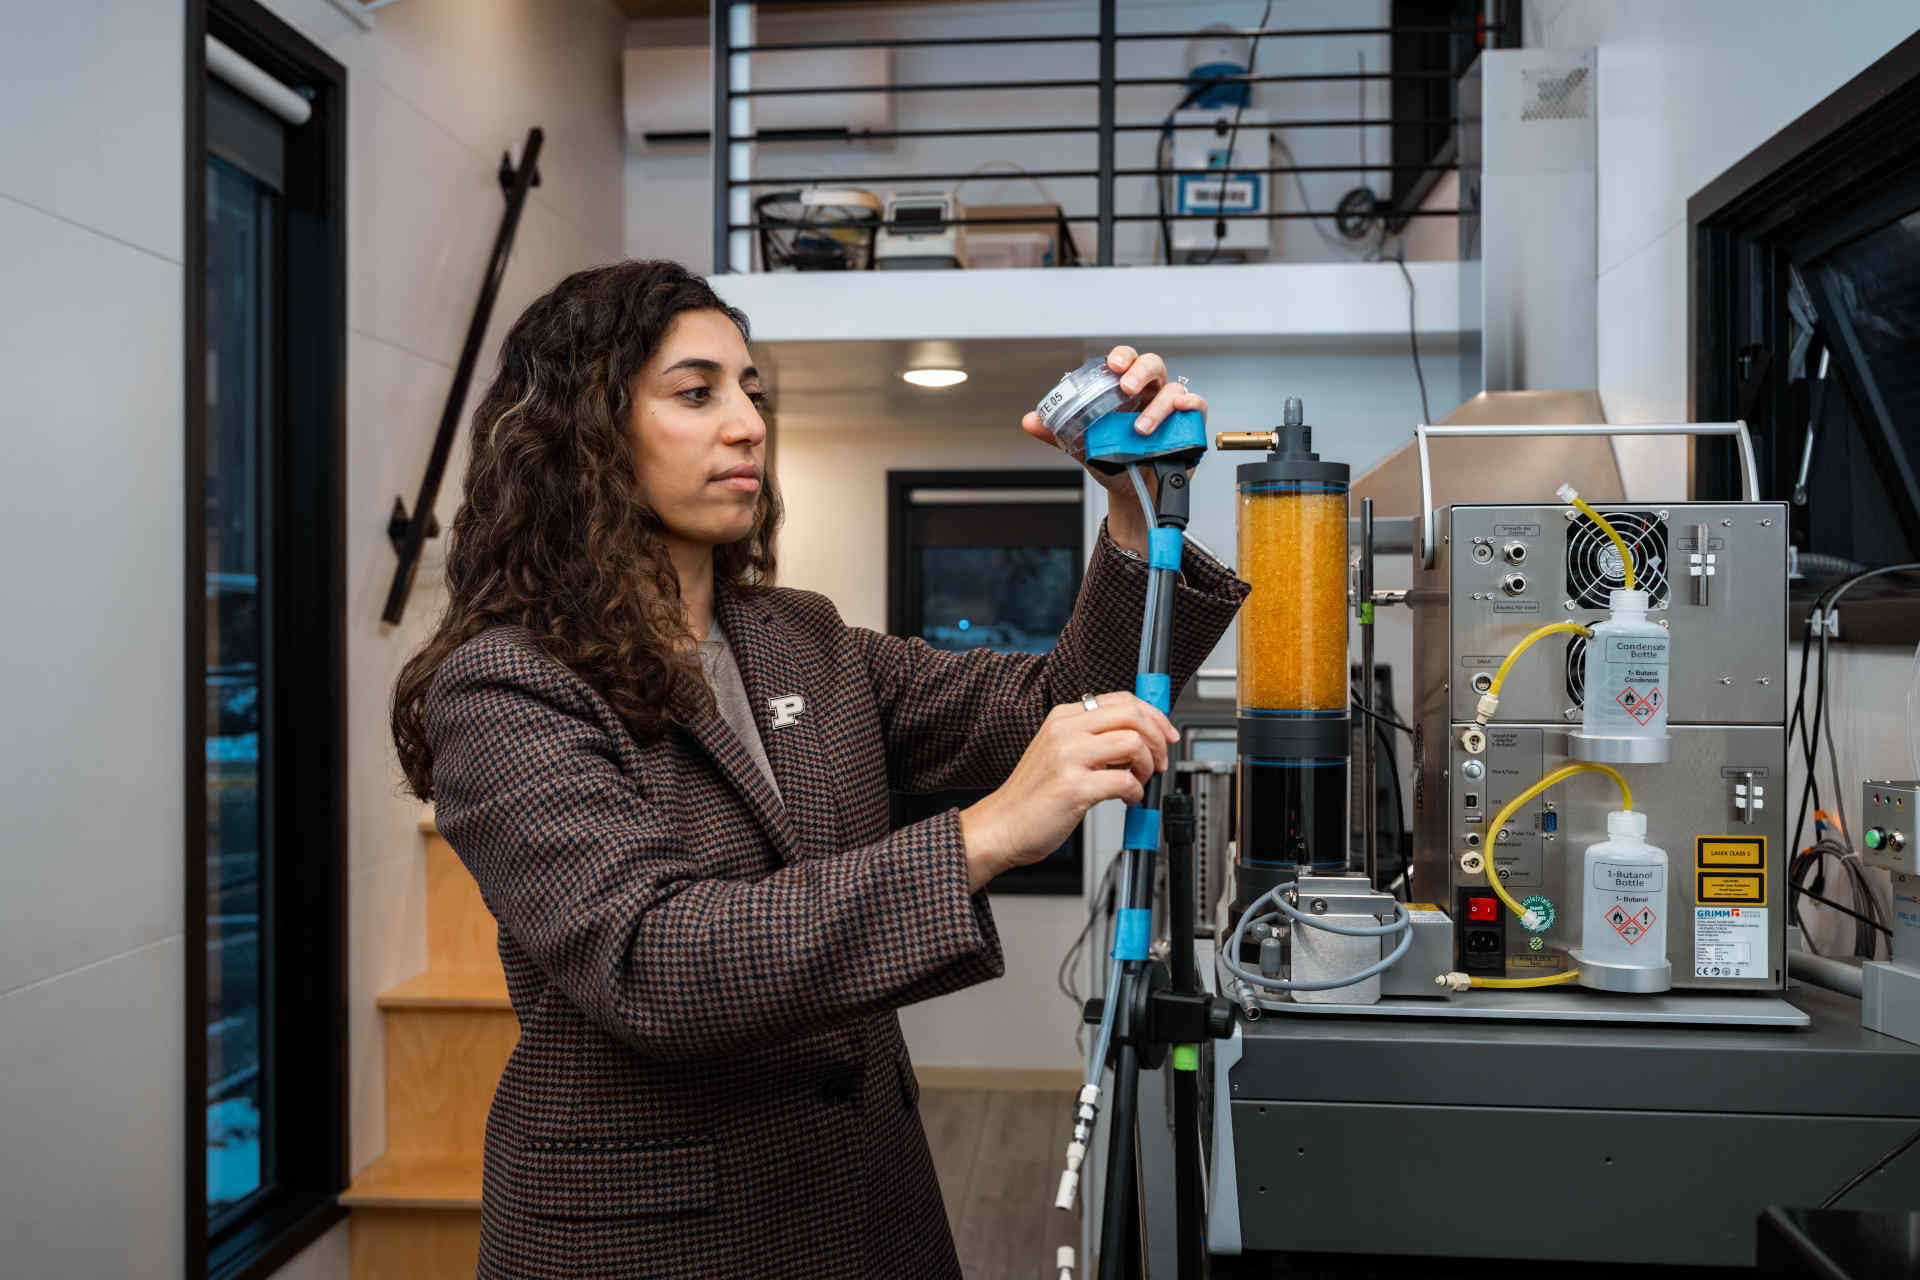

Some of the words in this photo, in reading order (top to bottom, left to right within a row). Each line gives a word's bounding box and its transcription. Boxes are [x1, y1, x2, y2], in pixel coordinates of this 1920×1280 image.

[1050, 392, 1063, 406] 05
[1631, 650, 1658, 658] Bottle
[768, 694, 806, 730] P
[1729, 849, 1746, 857] CLASS
[1607, 870, 1653, 879] 1-Butanol
[1615, 878, 1646, 887] Bottle
[1696, 909, 1731, 918] GRIMM
